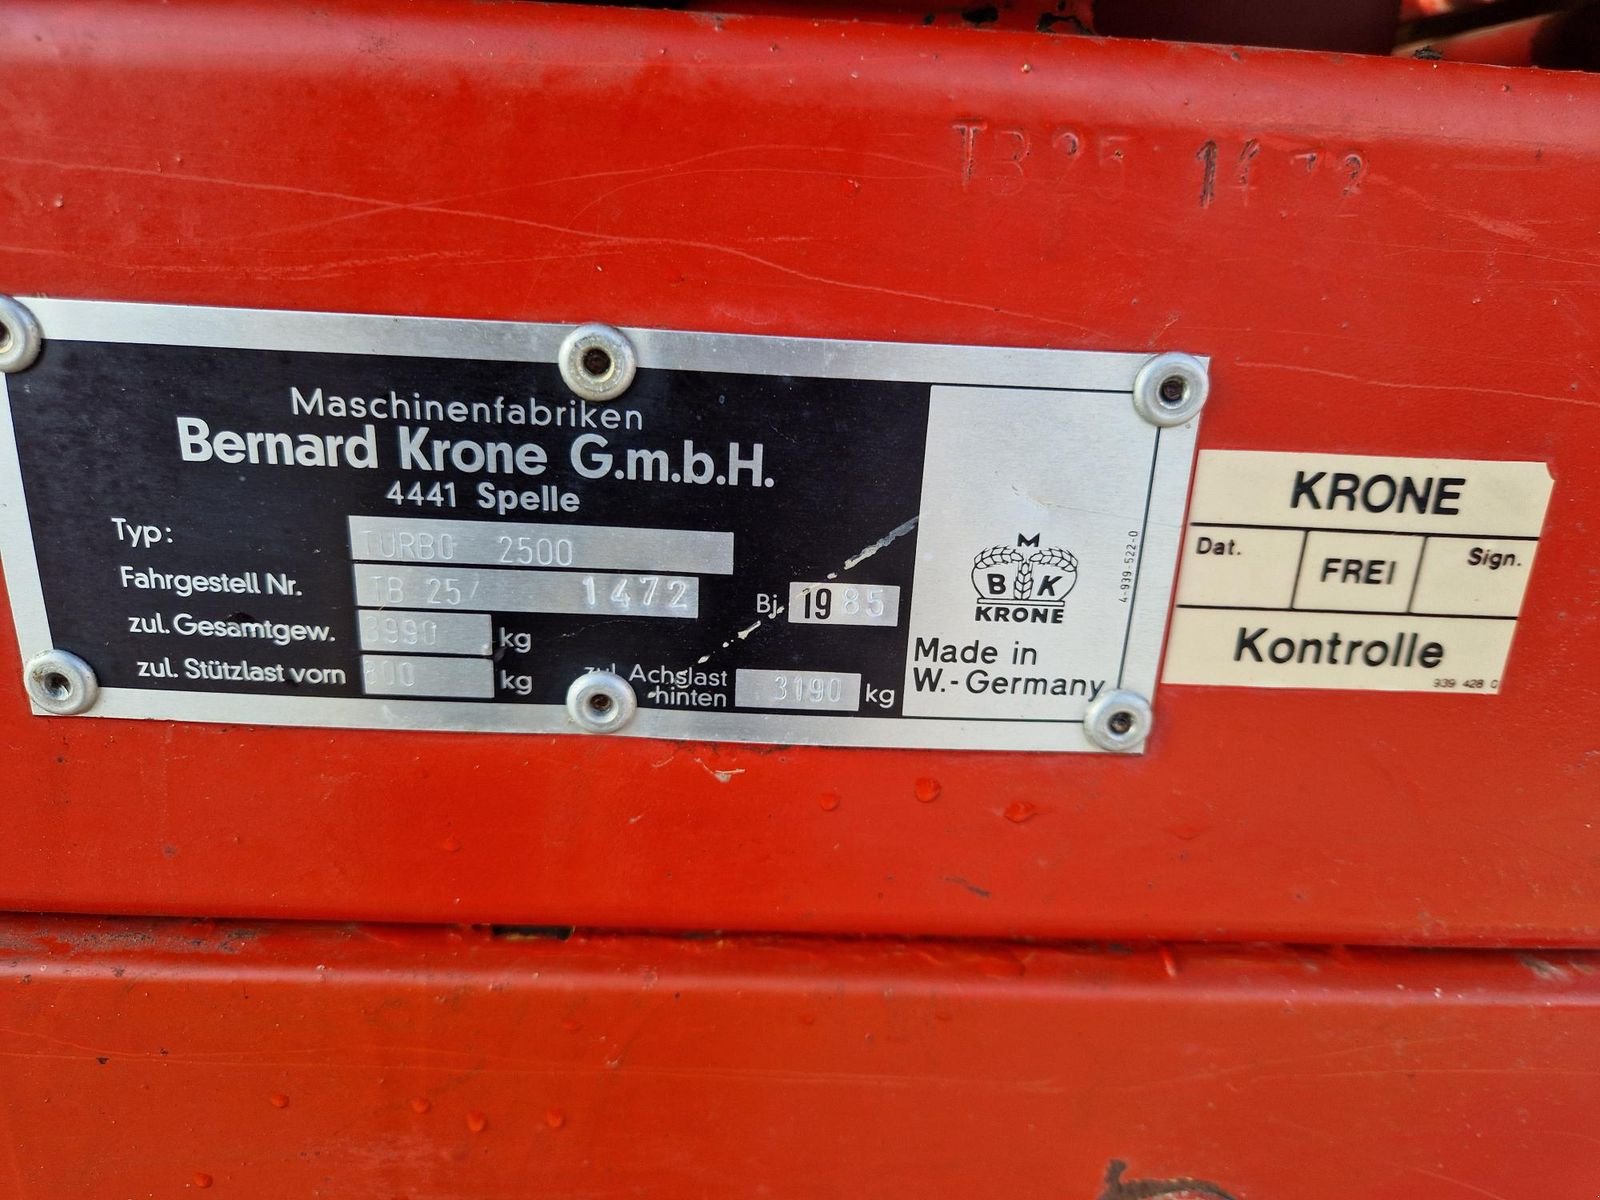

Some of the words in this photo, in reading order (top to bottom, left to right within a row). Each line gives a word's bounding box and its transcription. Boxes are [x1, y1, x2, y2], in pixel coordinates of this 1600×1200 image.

[291, 387, 644, 432] Maschinenfabriken
[177, 416, 378, 469] Bernard
[398, 425, 548, 476] Krone
[570, 433, 775, 487] G.m.b.H.
[387, 481, 456, 508] 4441
[478, 482, 581, 514] Spelle
[1291, 471, 1466, 515] KRONE
[111, 518, 173, 545] Typ:
[1018, 533, 1040, 547] M
[499, 536, 573, 566] 2500
[1196, 537, 1241, 556] Dat.
[1467, 547, 1521, 570] Sign.
[121, 566, 261, 597] Fahrgestell
[266, 573, 303, 596] Nr.
[987, 573, 1006, 595] B
[1037, 575, 1063, 596] K
[1320, 558, 1396, 585] FREI
[582, 576, 688, 609] 1472
[128, 613, 171, 634] zul.
[172, 613, 336, 646] Gesamtgew.
[975, 606, 1065, 624] KRONE
[501, 627, 532, 653] kg
[915, 637, 998, 664] Made
[1012, 641, 1037, 666] in
[1233, 628, 1445, 669] Kontrolle
[137, 657, 178, 679] zul.
[185, 658, 286, 688] Stützlast
[290, 667, 347, 685] vorn
[502, 668, 533, 697] kg
[629, 664, 728, 687] Achslast
[774, 676, 842, 702] 3190
[866, 684, 895, 709] kg
